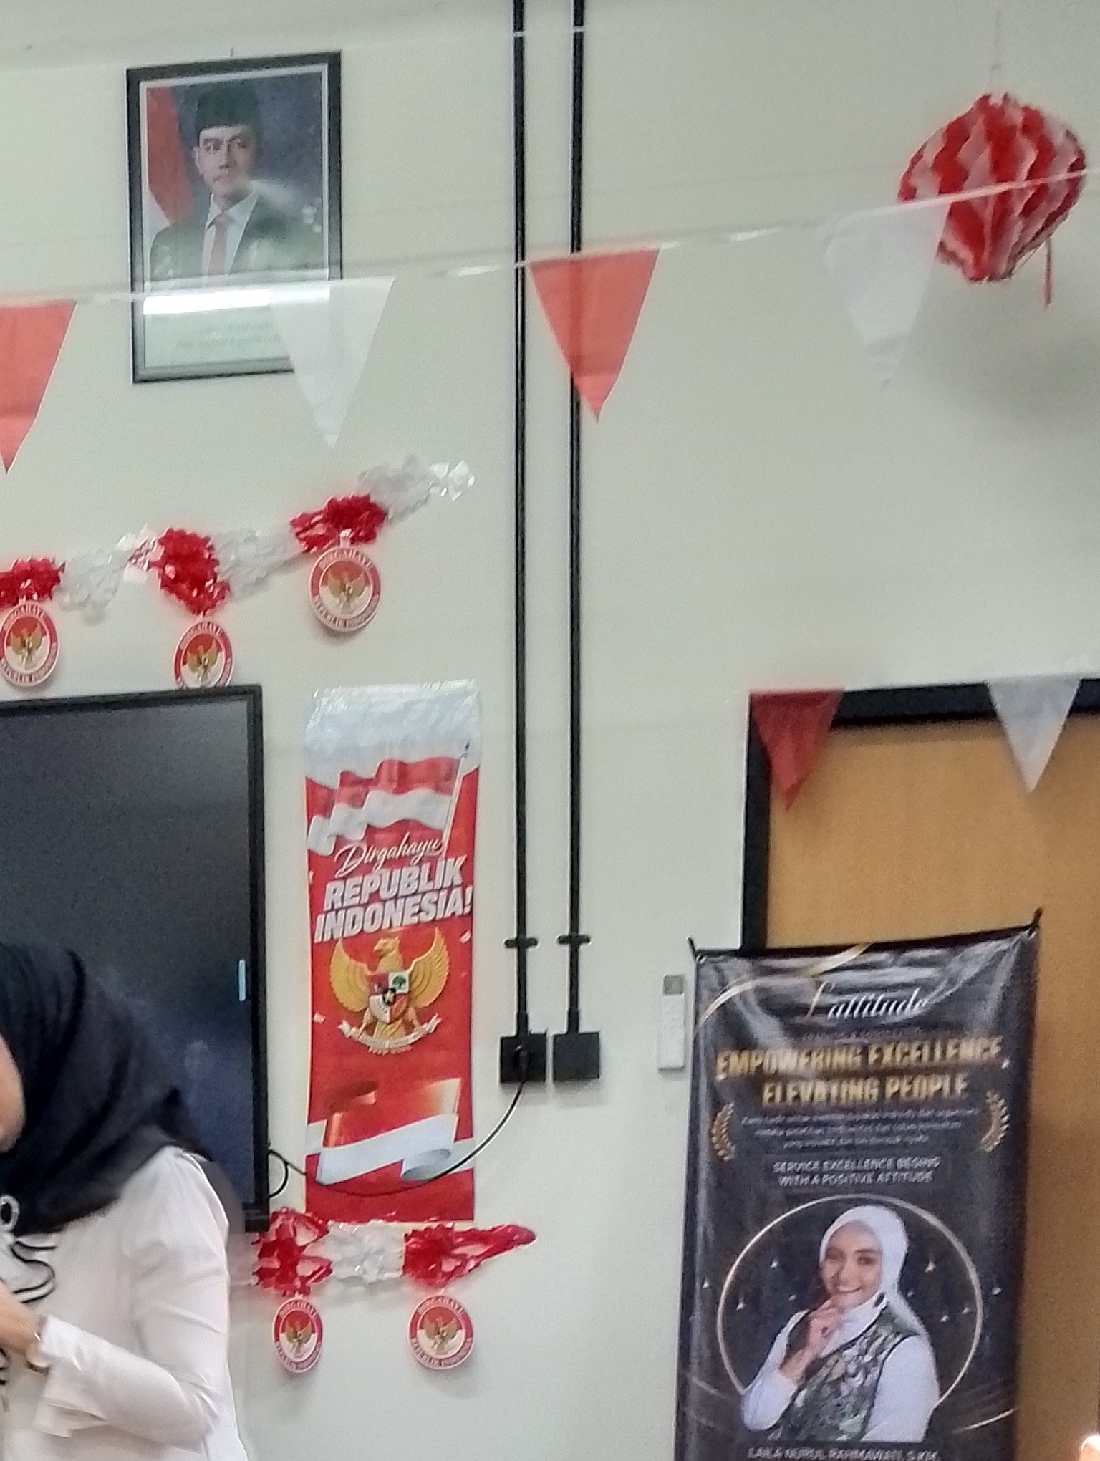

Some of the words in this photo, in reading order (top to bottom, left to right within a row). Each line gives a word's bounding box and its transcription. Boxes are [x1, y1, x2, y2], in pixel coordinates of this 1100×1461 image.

[334, 831, 444, 879] Dirgahayu
[324, 854, 467, 911] REPUBLIK
[314, 885, 474, 943] INDONESIA!
[867, 1036, 1002, 1067] EXCELLENCE
[884, 1072, 969, 1101] PEOPLE
